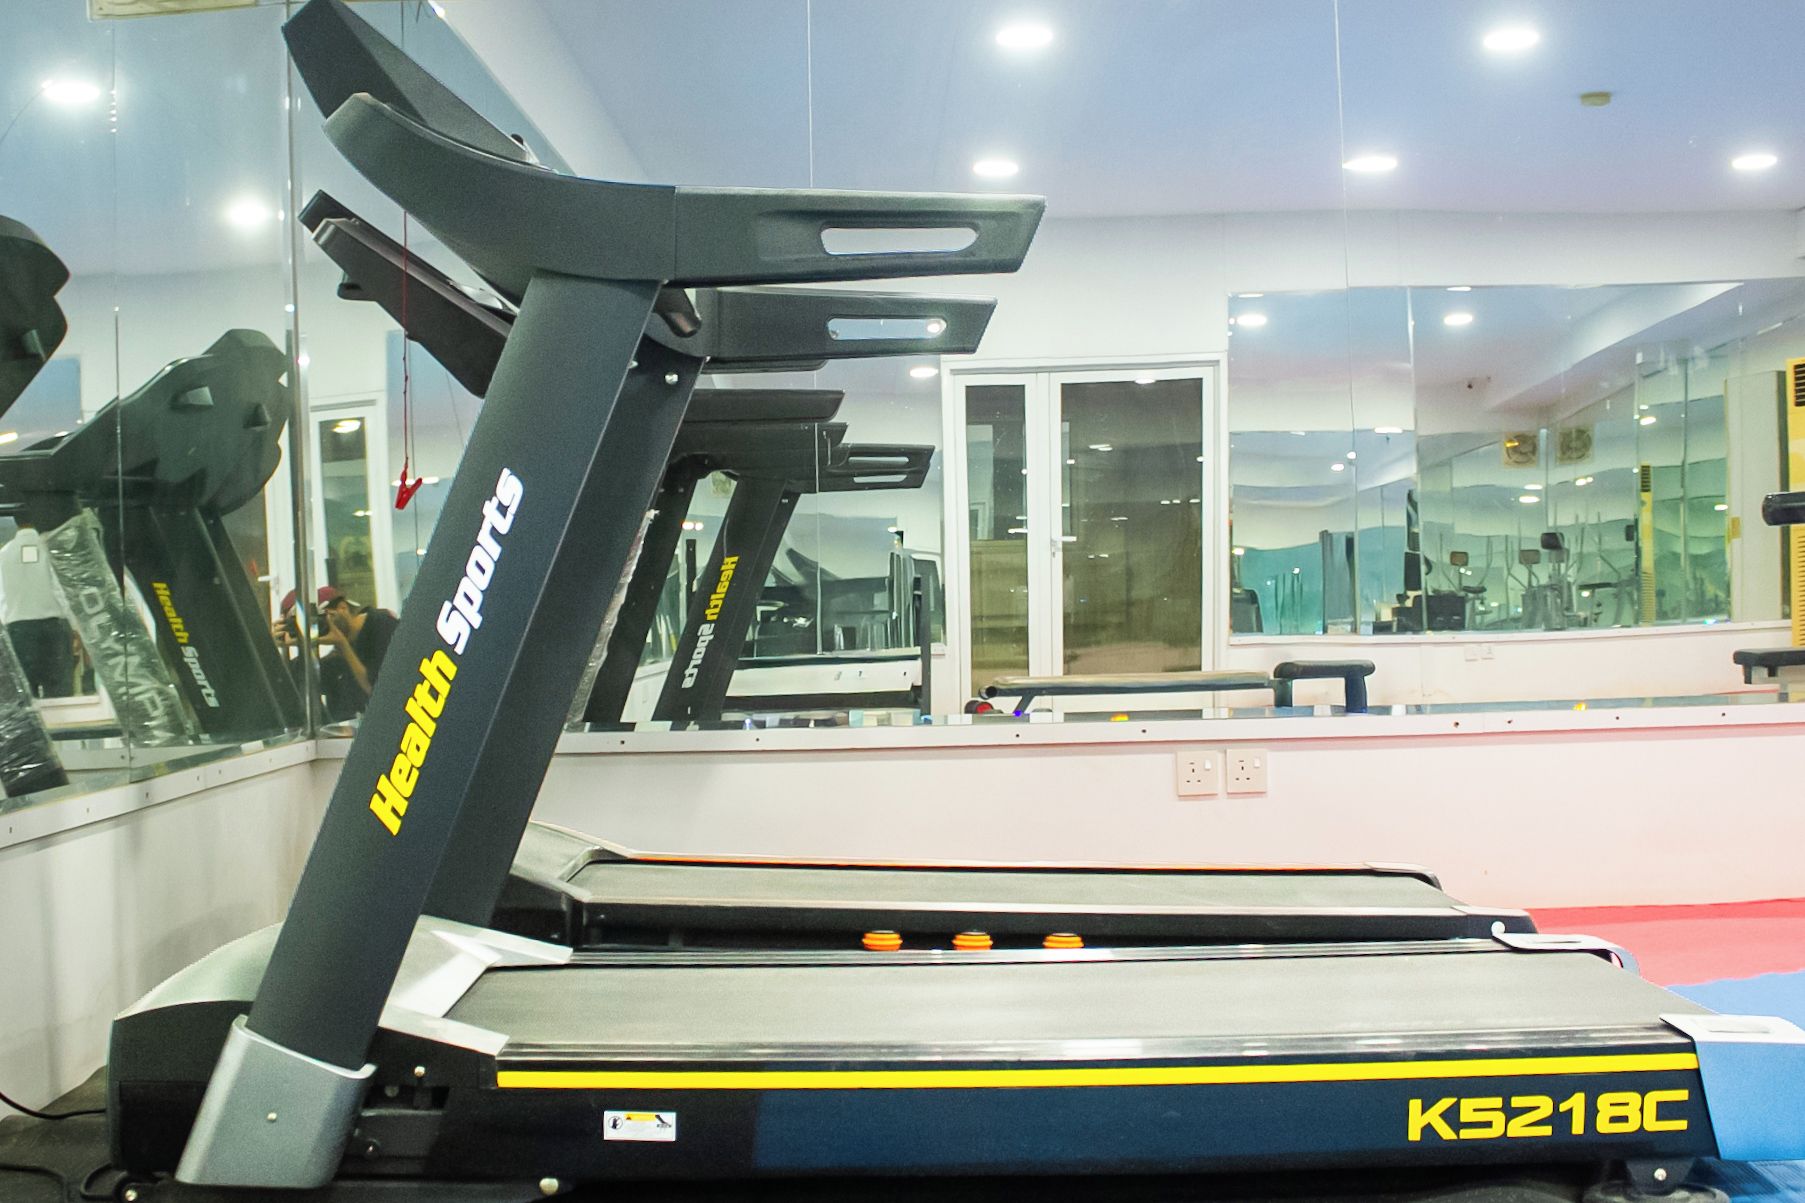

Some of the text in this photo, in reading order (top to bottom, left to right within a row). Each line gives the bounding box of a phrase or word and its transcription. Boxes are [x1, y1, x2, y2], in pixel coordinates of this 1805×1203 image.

[152, 582, 220, 708] Health Sports
[370, 467, 524, 836] Health Sports
[1408, 1089, 1689, 1141] K5218C
